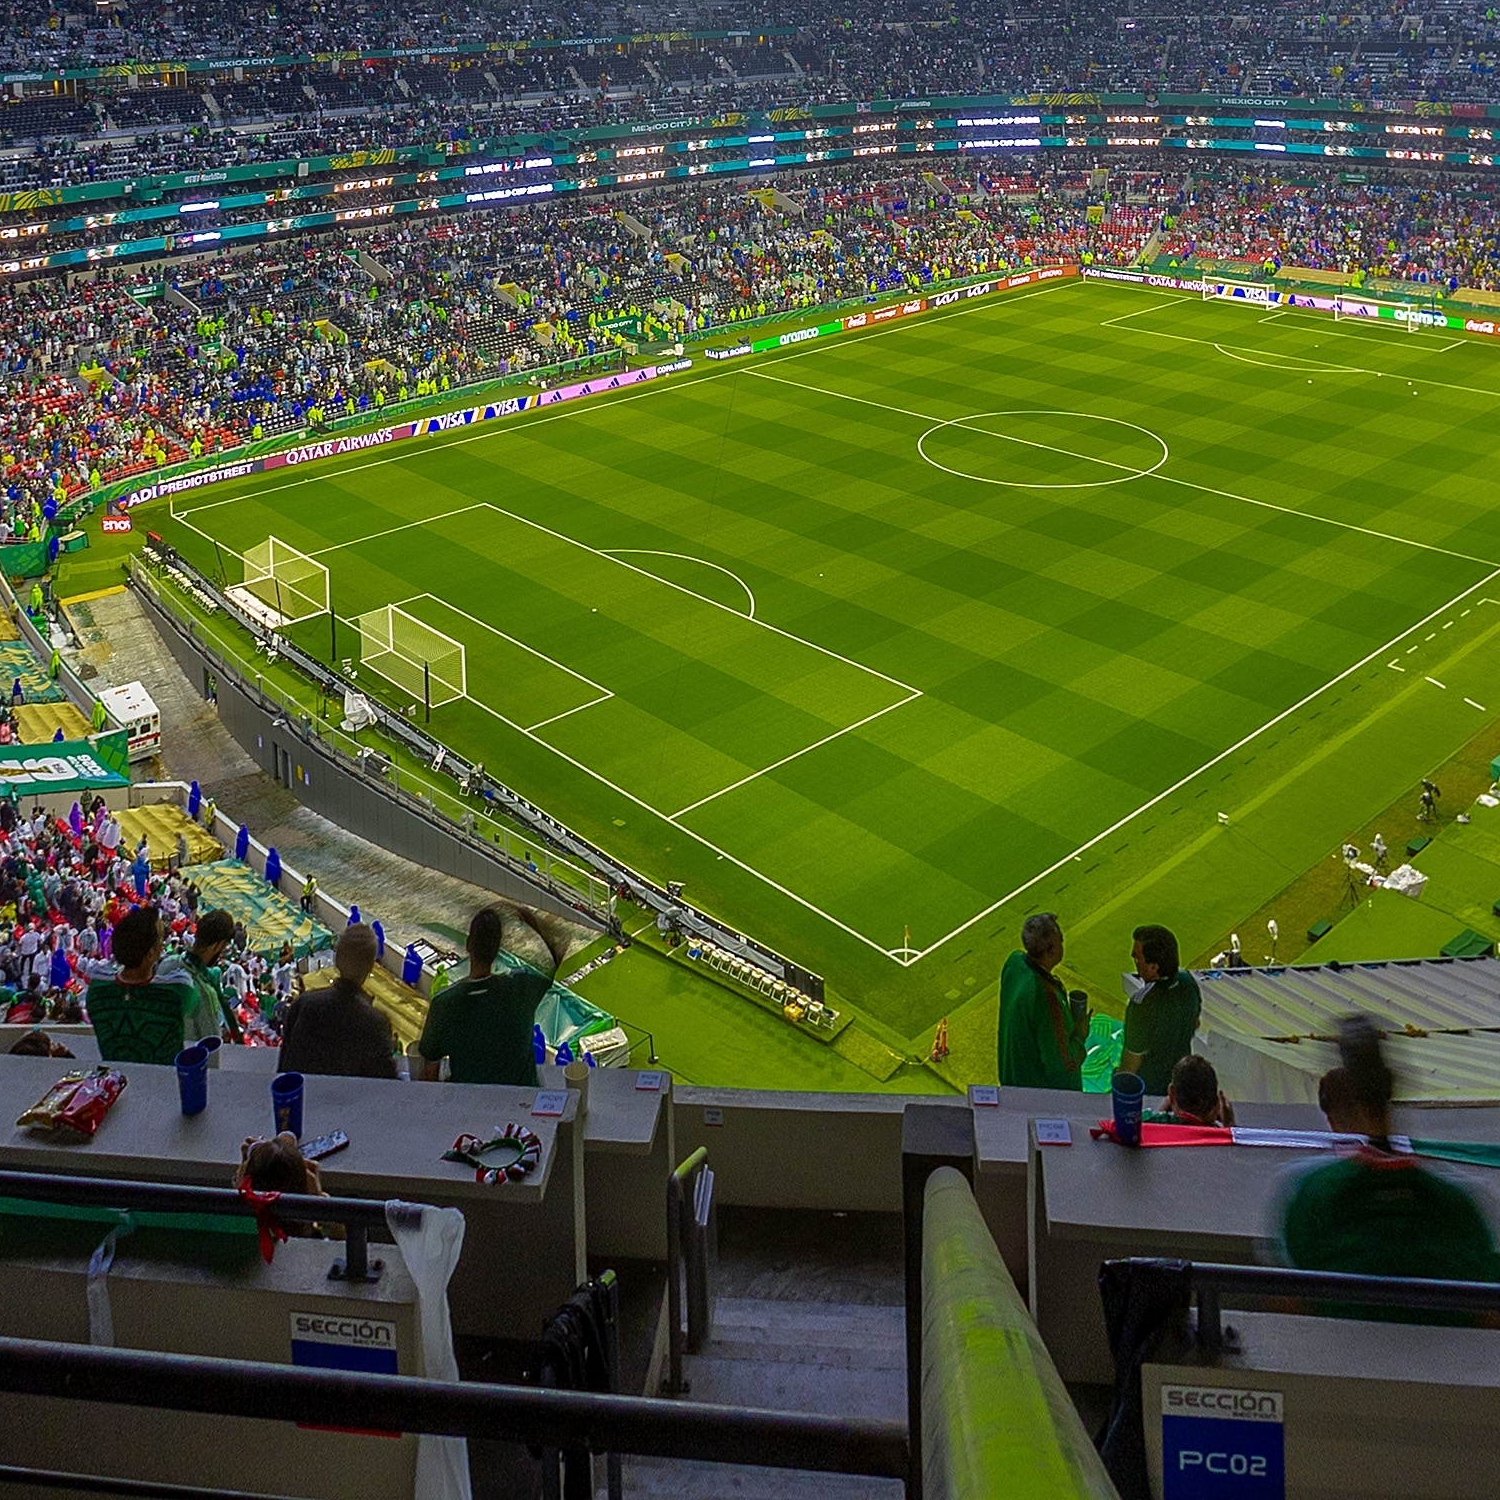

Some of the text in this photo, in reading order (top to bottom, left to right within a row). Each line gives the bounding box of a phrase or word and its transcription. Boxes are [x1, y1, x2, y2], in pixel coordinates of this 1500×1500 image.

[1222, 98, 1262, 106] MEXICO
[1008, 275, 1031, 287] Lenovo
[1149, 273, 1217, 293] QATAR AIRWAYS
[1244, 285, 1268, 301] VISA
[779, 326, 819, 345] aramco
[493, 399, 520, 417] VISA
[437, 413, 466, 430] VISA
[286, 430, 393, 465] QATAR AIRWAYS
[128, 463, 254, 507] ADI PREDICTSTREET
[1179, 1450, 1267, 1476] PC02
